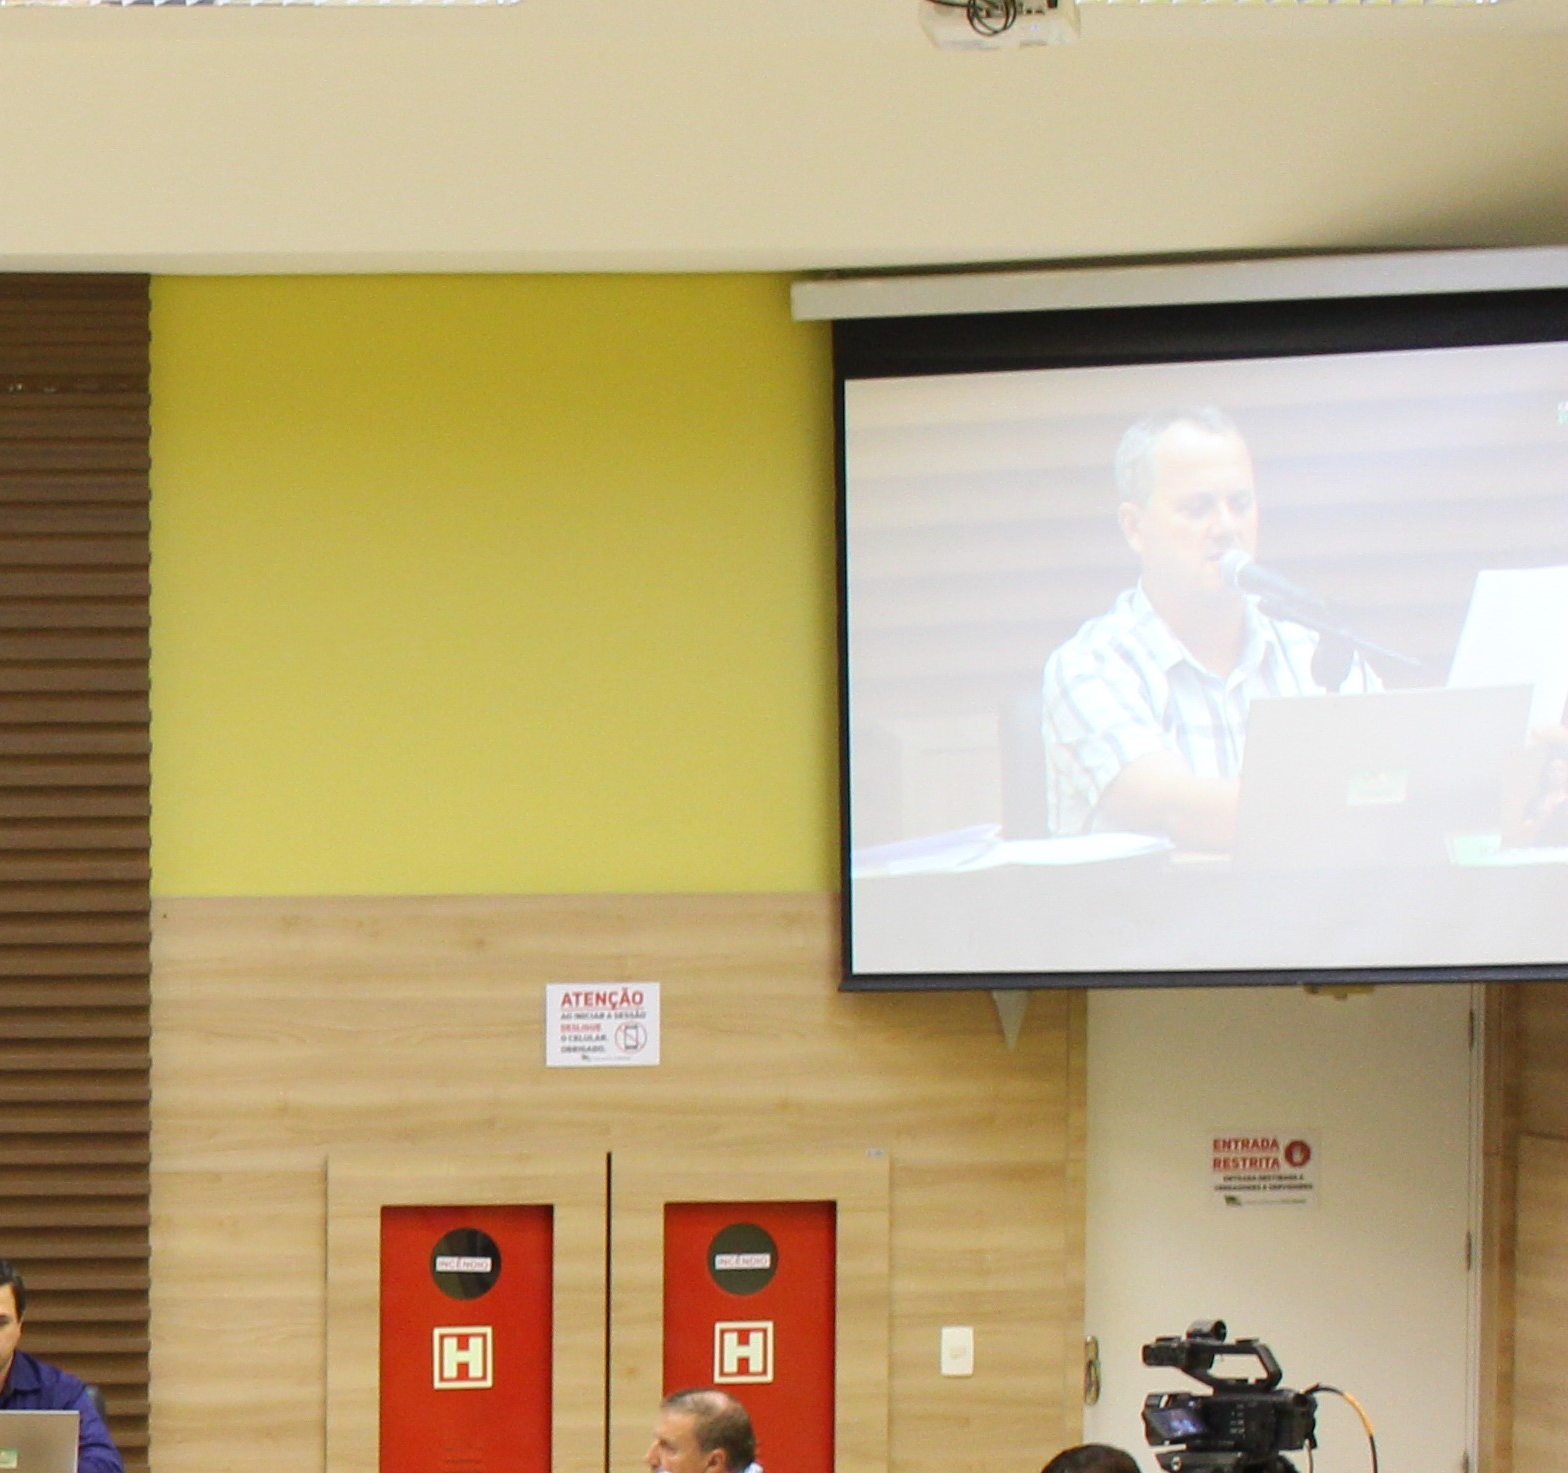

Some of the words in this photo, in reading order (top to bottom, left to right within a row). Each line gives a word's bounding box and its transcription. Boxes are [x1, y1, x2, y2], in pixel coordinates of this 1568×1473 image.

[561, 987, 644, 1010] ATENÇÃO
[1213, 1138, 1279, 1152] ENTRADA
[1213, 1157, 1280, 1171] RESTRITA
[443, 1336, 484, 1378] H
[723, 1331, 764, 1373] H
